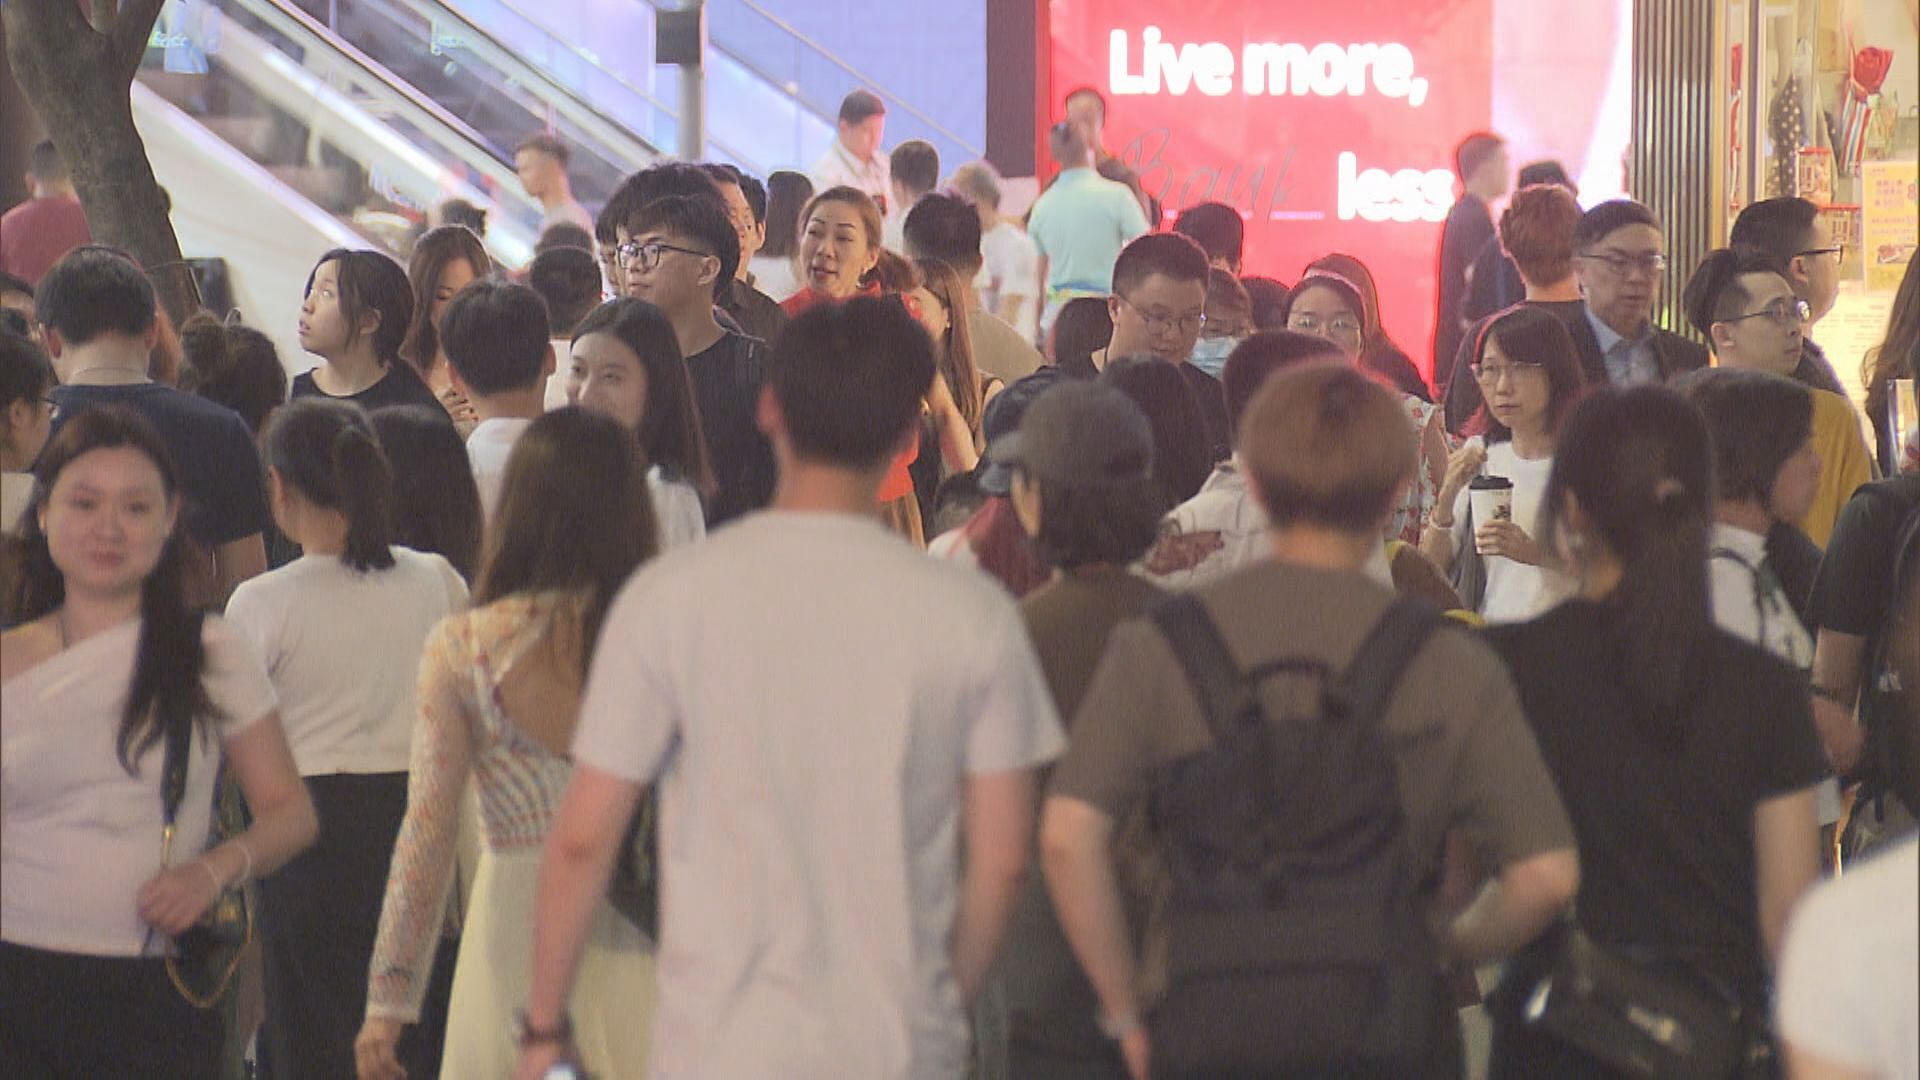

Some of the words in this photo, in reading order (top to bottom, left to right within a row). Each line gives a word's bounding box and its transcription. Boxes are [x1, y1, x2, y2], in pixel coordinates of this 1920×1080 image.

[1109, 25, 1235, 97] Live
[1241, 42, 1429, 107] more,
[1337, 151, 1456, 222] less
